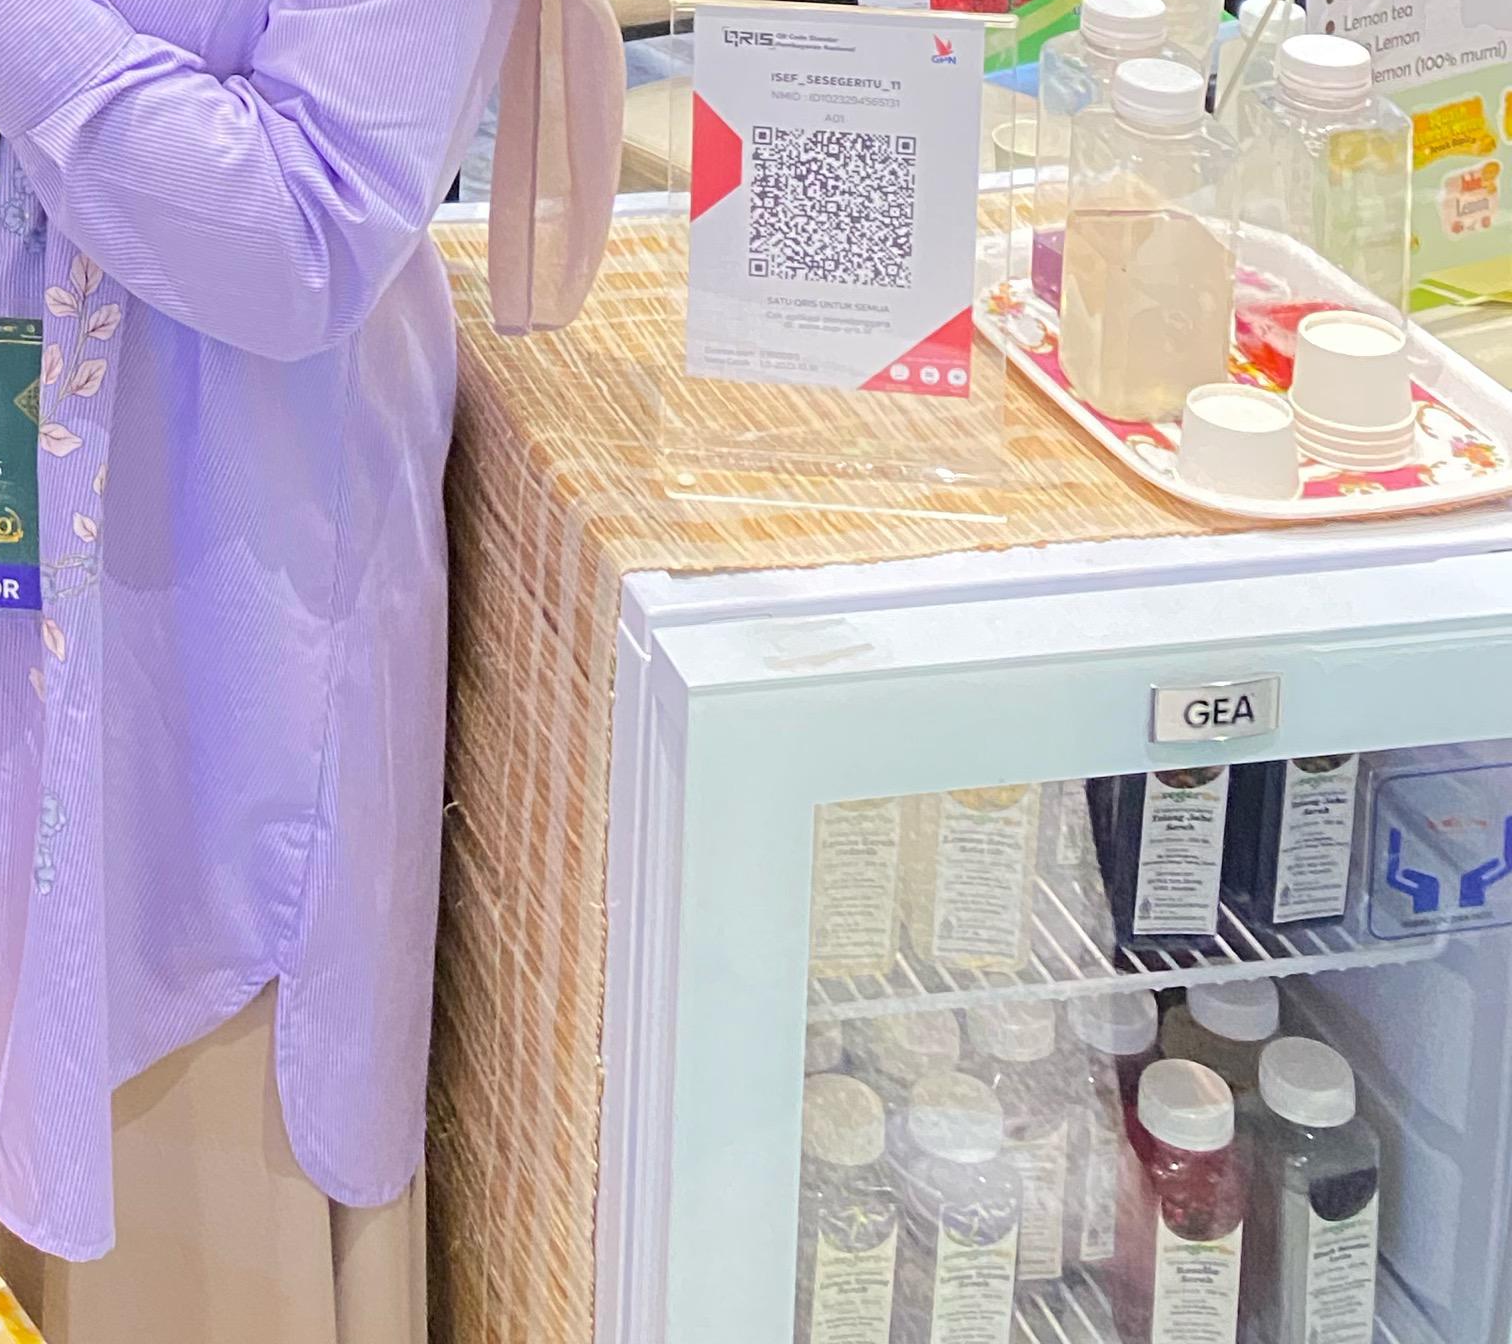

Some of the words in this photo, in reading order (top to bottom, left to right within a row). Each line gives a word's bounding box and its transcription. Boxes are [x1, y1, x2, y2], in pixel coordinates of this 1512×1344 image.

[1344, 13, 1388, 33] Lemon
[1392, 4, 1413, 20] tea
[724, 28, 774, 47] QRIS
[1376, 32, 1420, 53] Lemon
[1184, 695, 1255, 729] GEA
